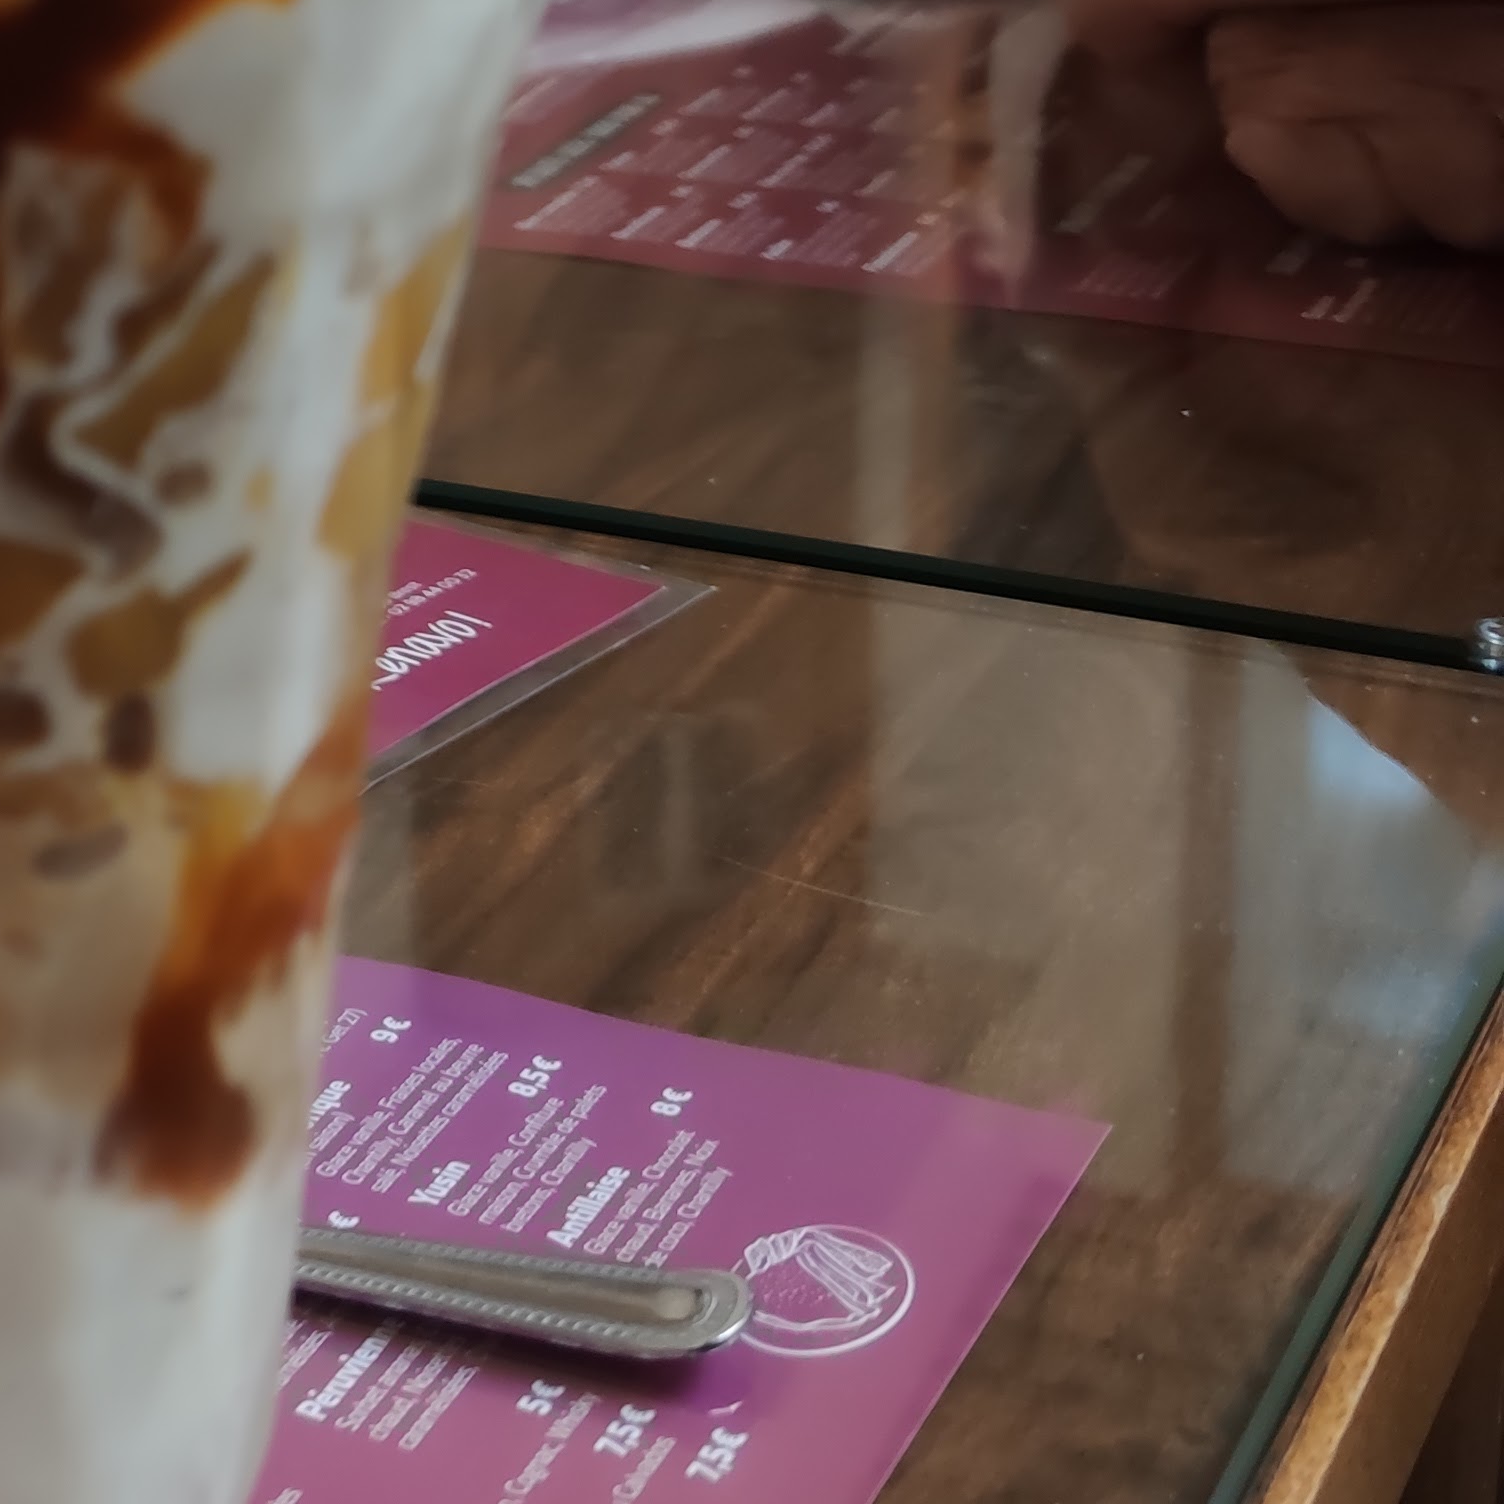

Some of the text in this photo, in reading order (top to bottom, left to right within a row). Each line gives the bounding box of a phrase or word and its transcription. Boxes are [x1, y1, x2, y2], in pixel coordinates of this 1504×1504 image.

[370, 1016, 412, 1044] 9€
[440, 1043, 485, 1078] beurre
[432, 1076, 455, 1093] au
[388, 1089, 440, 1135] Caramel
[407, 1055, 562, 1206] Yusin 8,5€
[315, 1144, 359, 1178] Glace
[447, 1183, 490, 1217] Glace
[508, 1097, 564, 1147] Confiture
[546, 1087, 693, 1249] Antillaise 8€
[583, 1220, 625, 1255] Glace
[516, 1379, 566, 1416] 5€
